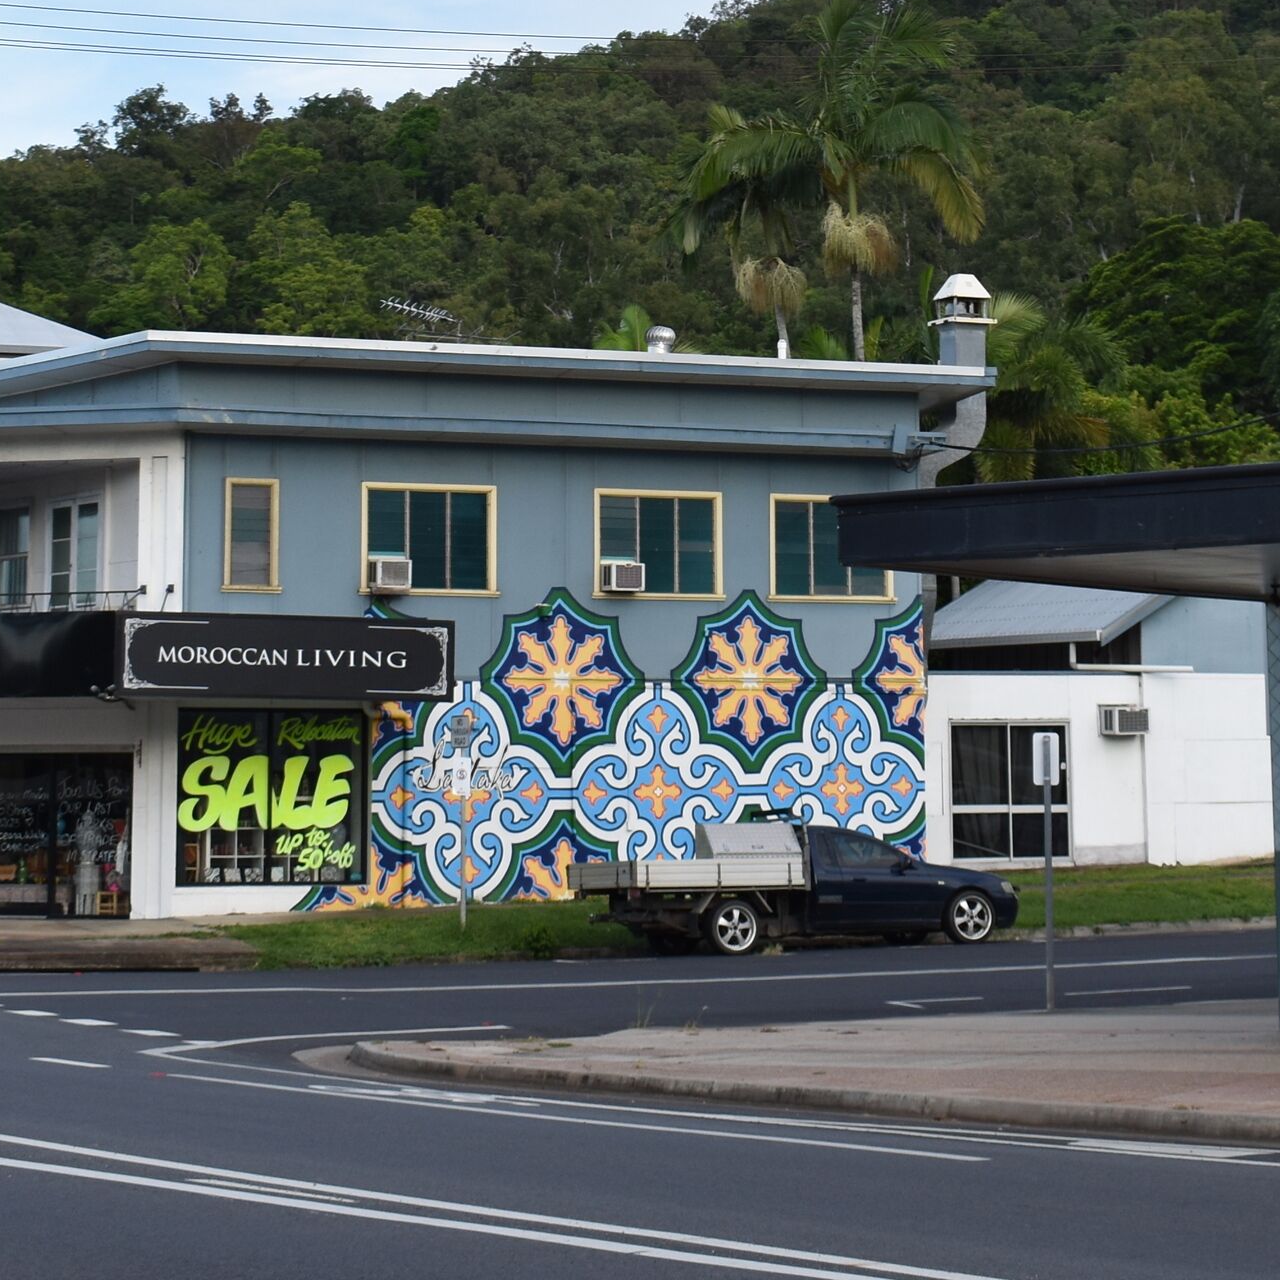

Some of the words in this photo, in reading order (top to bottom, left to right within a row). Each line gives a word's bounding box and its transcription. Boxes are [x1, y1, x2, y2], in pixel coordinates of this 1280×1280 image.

[158, 646, 288, 666] MOROCCAN
[297, 649, 408, 669] LIVING
[181, 714, 258, 754] Huge
[277, 715, 361, 749] Relocation
[177, 754, 355, 832] SALE
